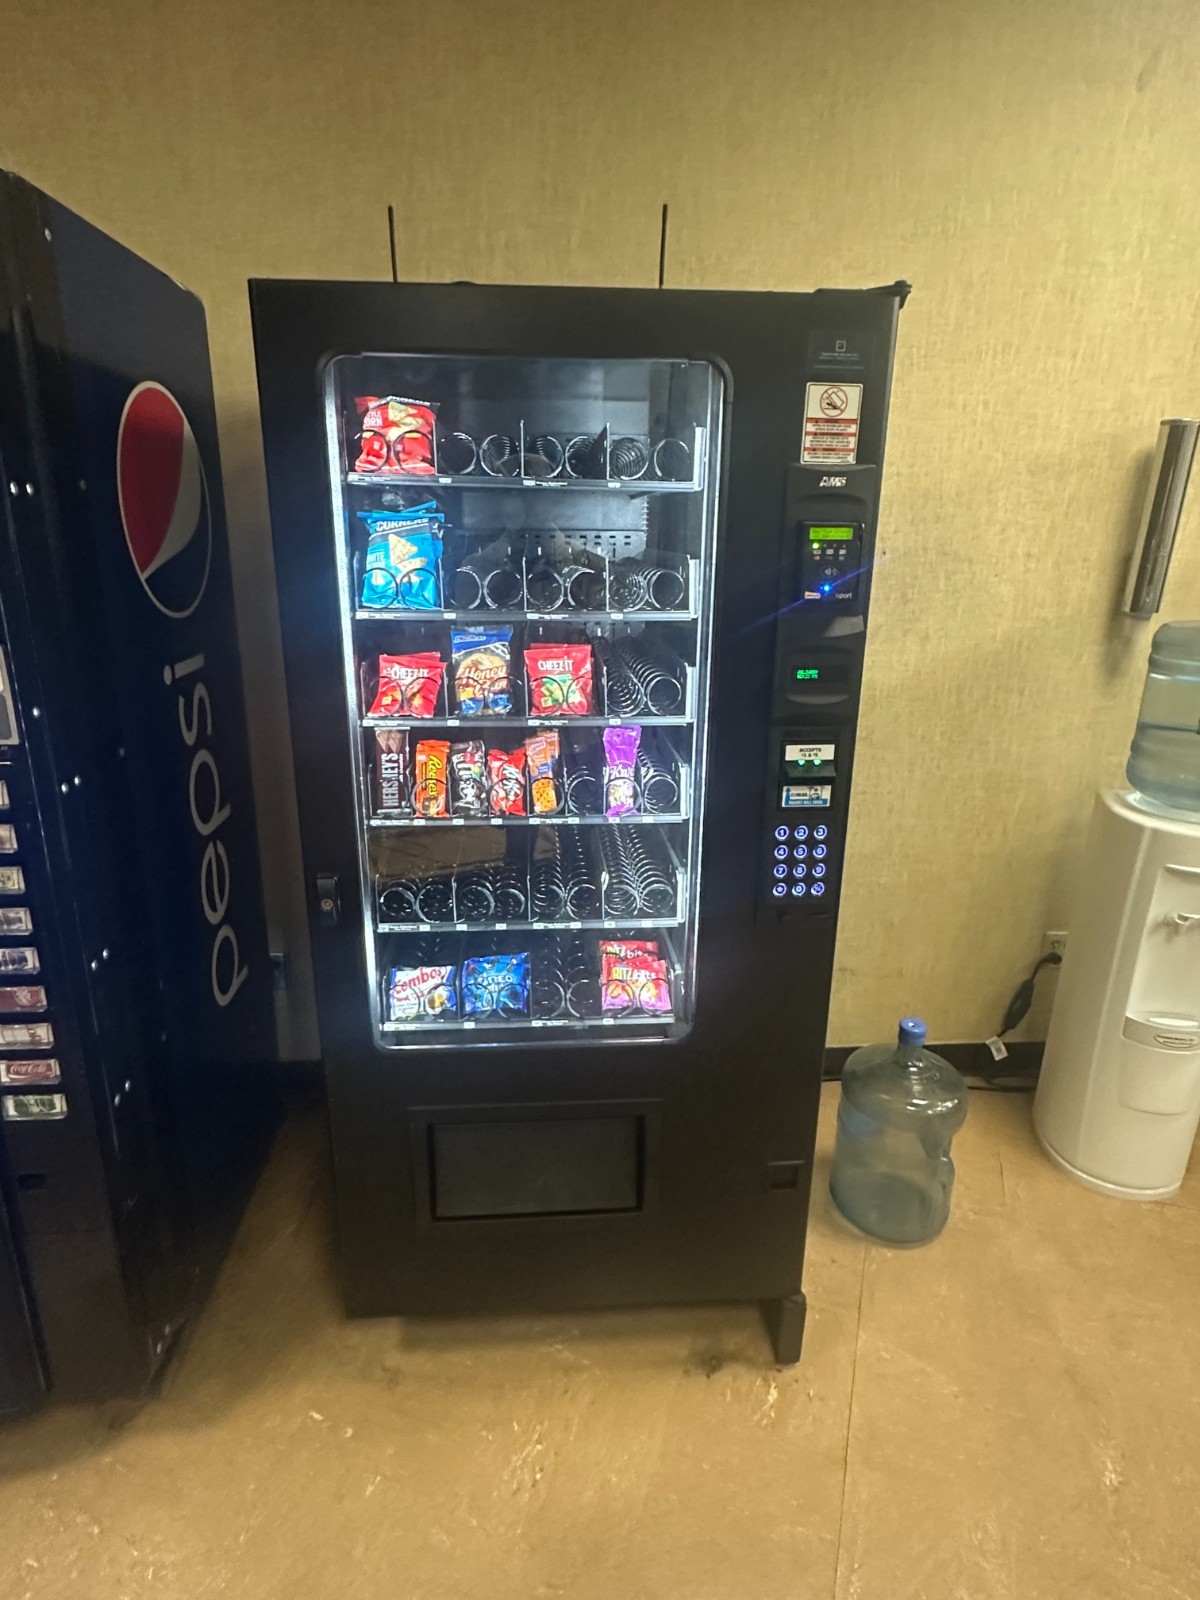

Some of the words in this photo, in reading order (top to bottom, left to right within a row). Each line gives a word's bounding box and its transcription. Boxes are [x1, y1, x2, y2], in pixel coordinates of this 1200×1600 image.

[819, 476, 847, 487] AMS
[394, 966, 442, 994] Combos
[612, 966, 632, 980] RITZ
[632, 969, 656, 981] bits
